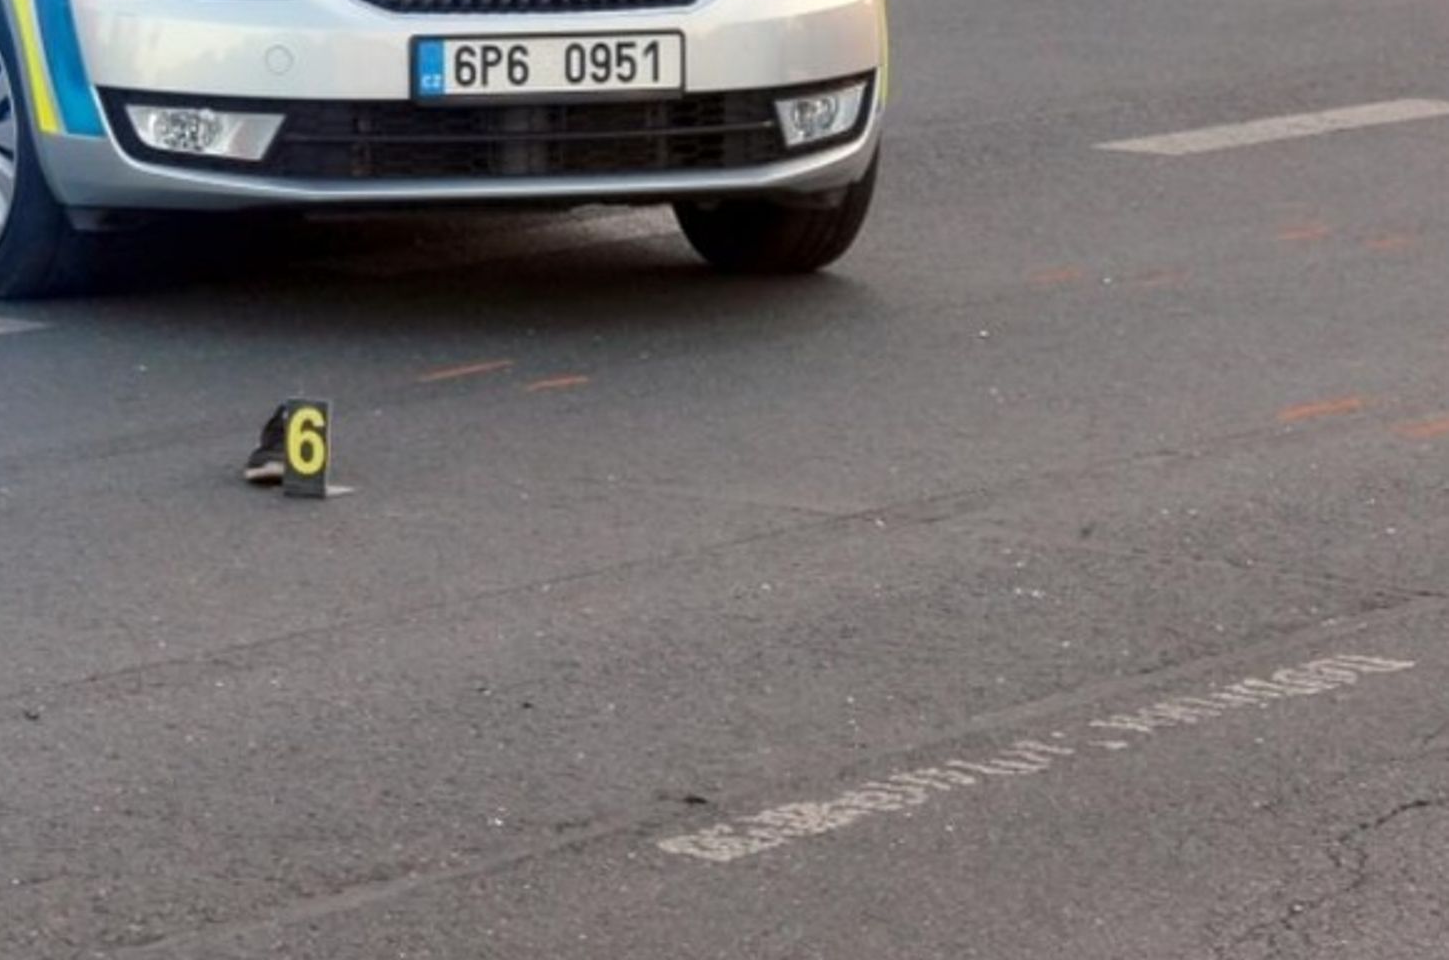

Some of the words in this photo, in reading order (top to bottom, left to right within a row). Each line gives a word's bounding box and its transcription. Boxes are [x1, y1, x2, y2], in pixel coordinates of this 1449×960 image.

[420, 73, 441, 88] CZ
[453, 44, 530, 87] 6P6
[564, 40, 661, 84] 0951
[287, 406, 325, 475] 6
